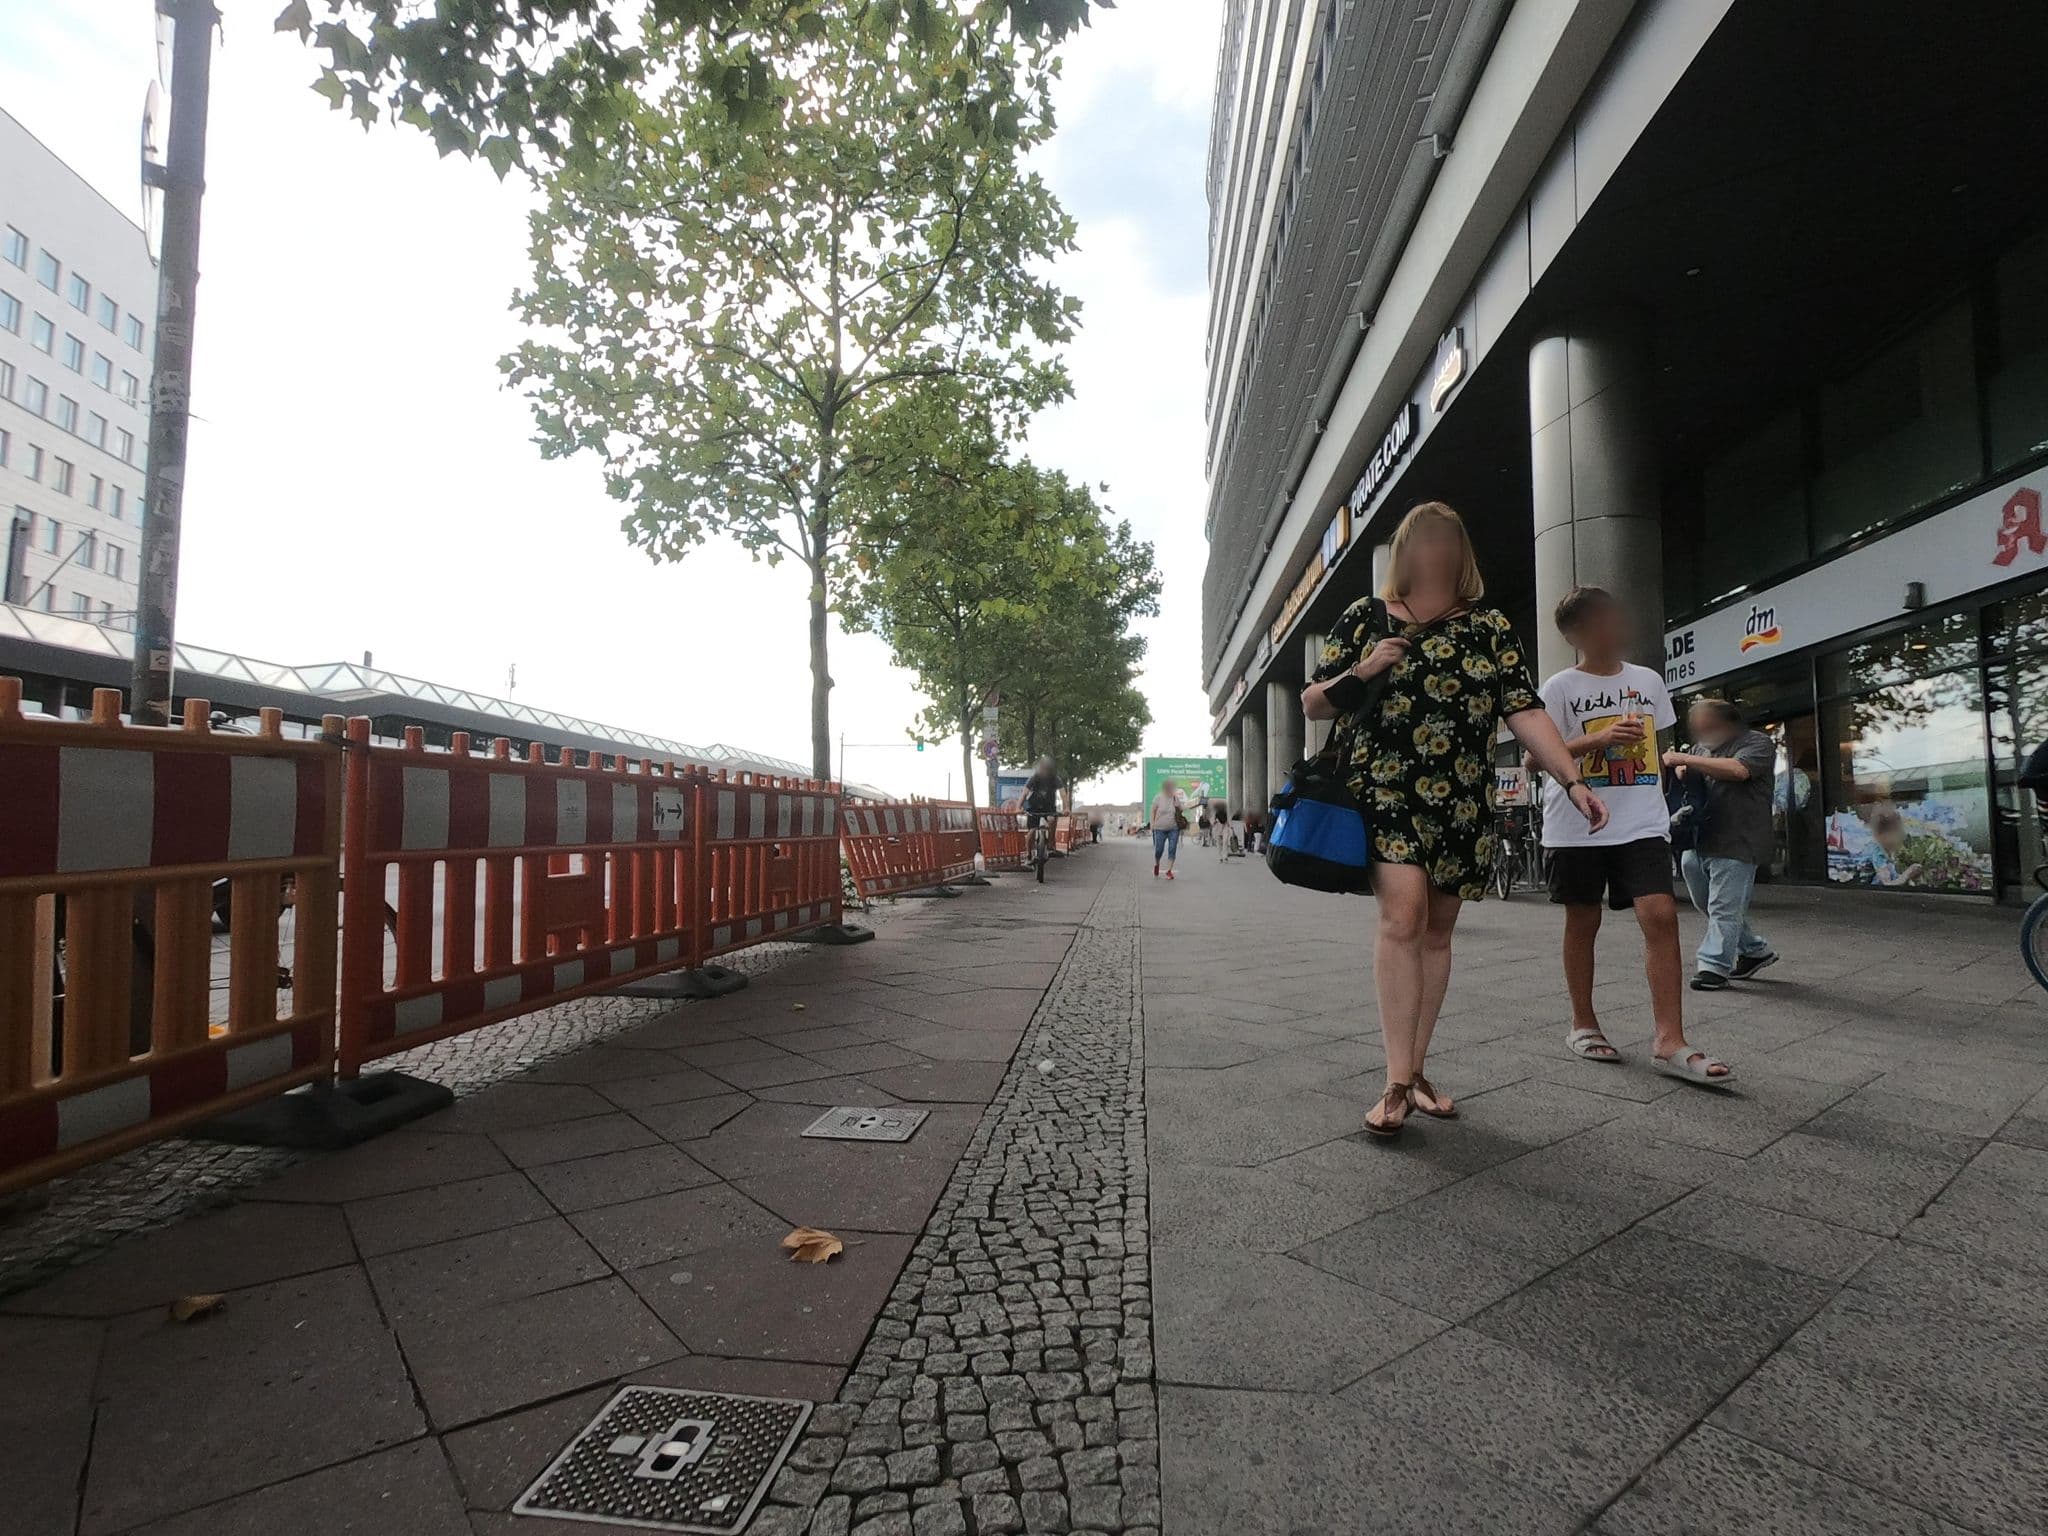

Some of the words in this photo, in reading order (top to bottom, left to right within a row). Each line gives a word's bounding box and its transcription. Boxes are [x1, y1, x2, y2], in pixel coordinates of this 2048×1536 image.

[1351, 402, 1410, 518] PIRATE.COM
[1746, 606, 1774, 635] dm
[1664, 630, 1695, 662] .DE
[1570, 691, 1617, 717] Keith
